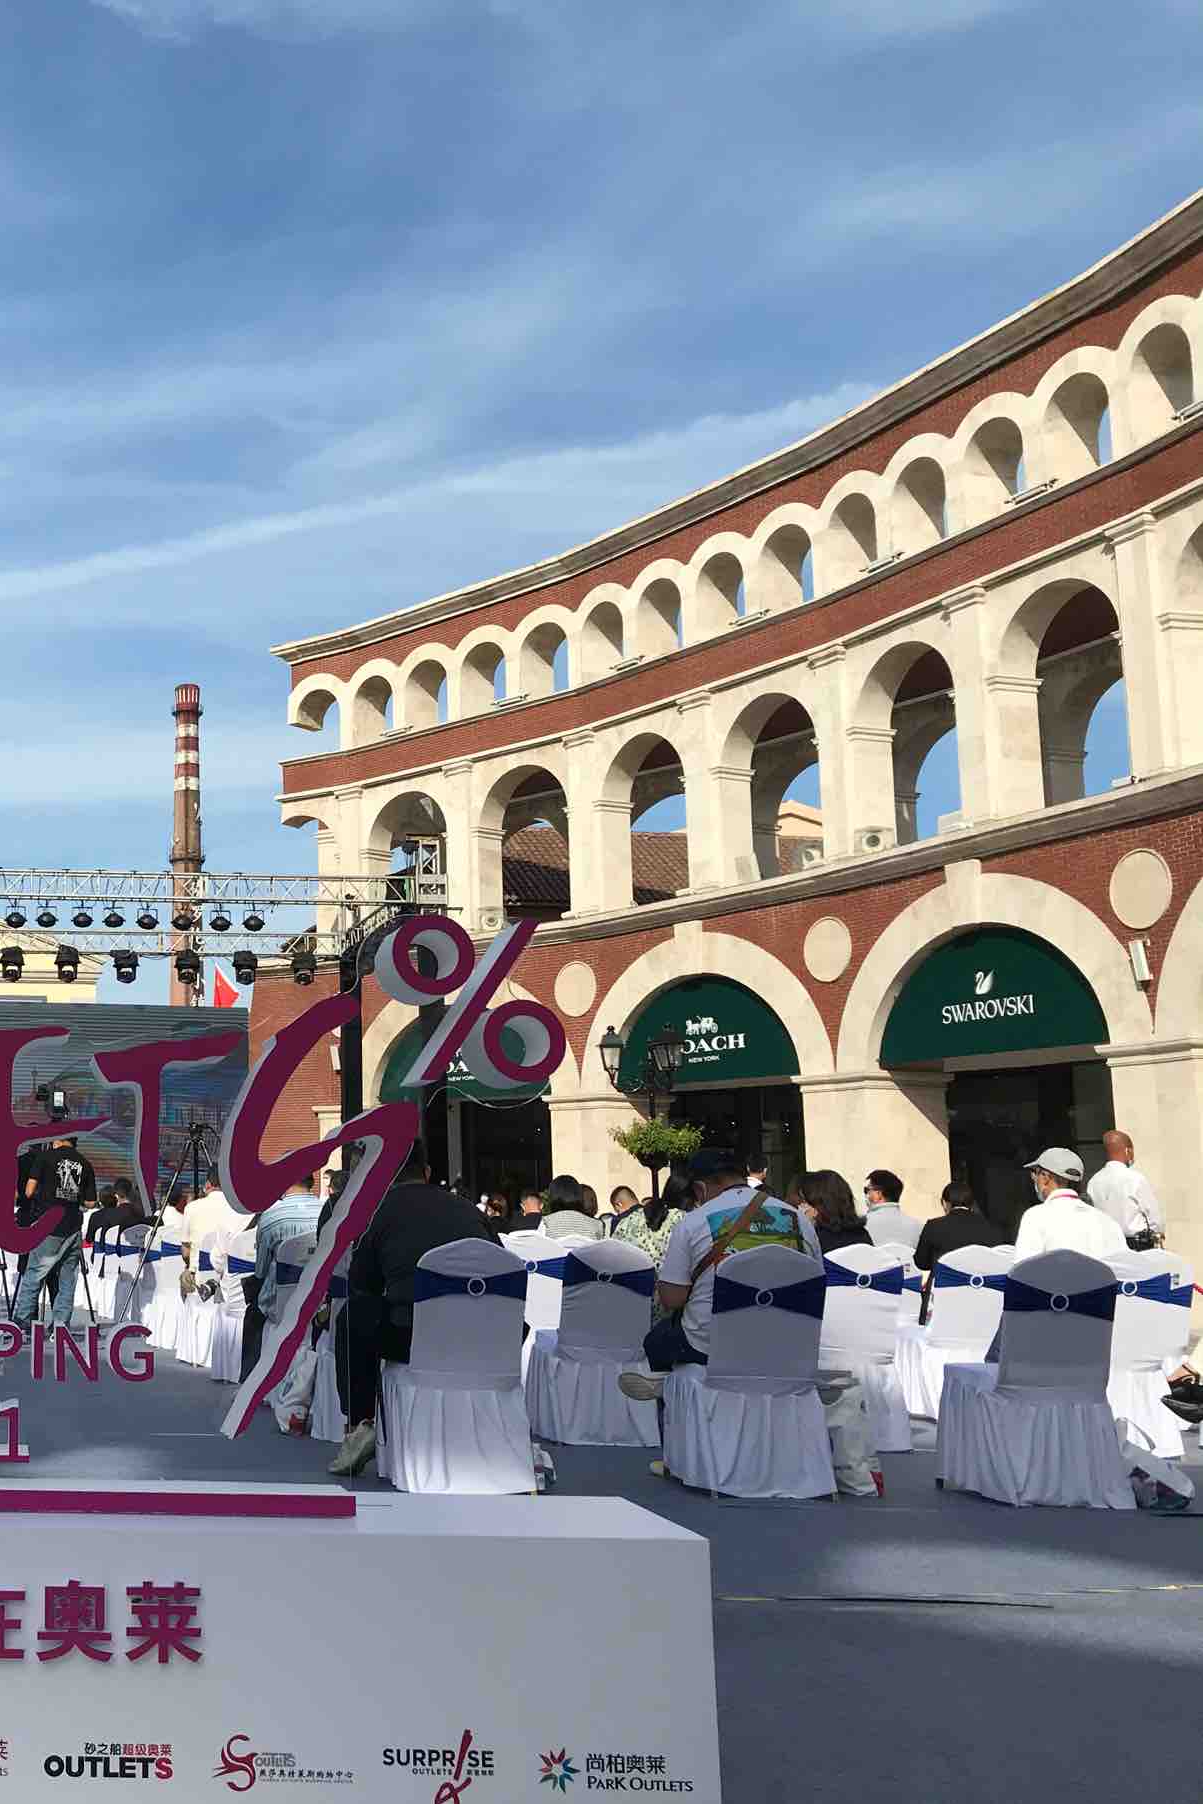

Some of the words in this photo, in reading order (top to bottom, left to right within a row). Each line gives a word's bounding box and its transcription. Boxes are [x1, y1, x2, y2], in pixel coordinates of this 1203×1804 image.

[942, 994, 1034, 1024] SWAROVSKI
[680, 1032, 746, 1054] OACH
[44, 1755, 173, 1779] OUTLETS
[586, 1753, 666, 1774] 尚柏奥莱
